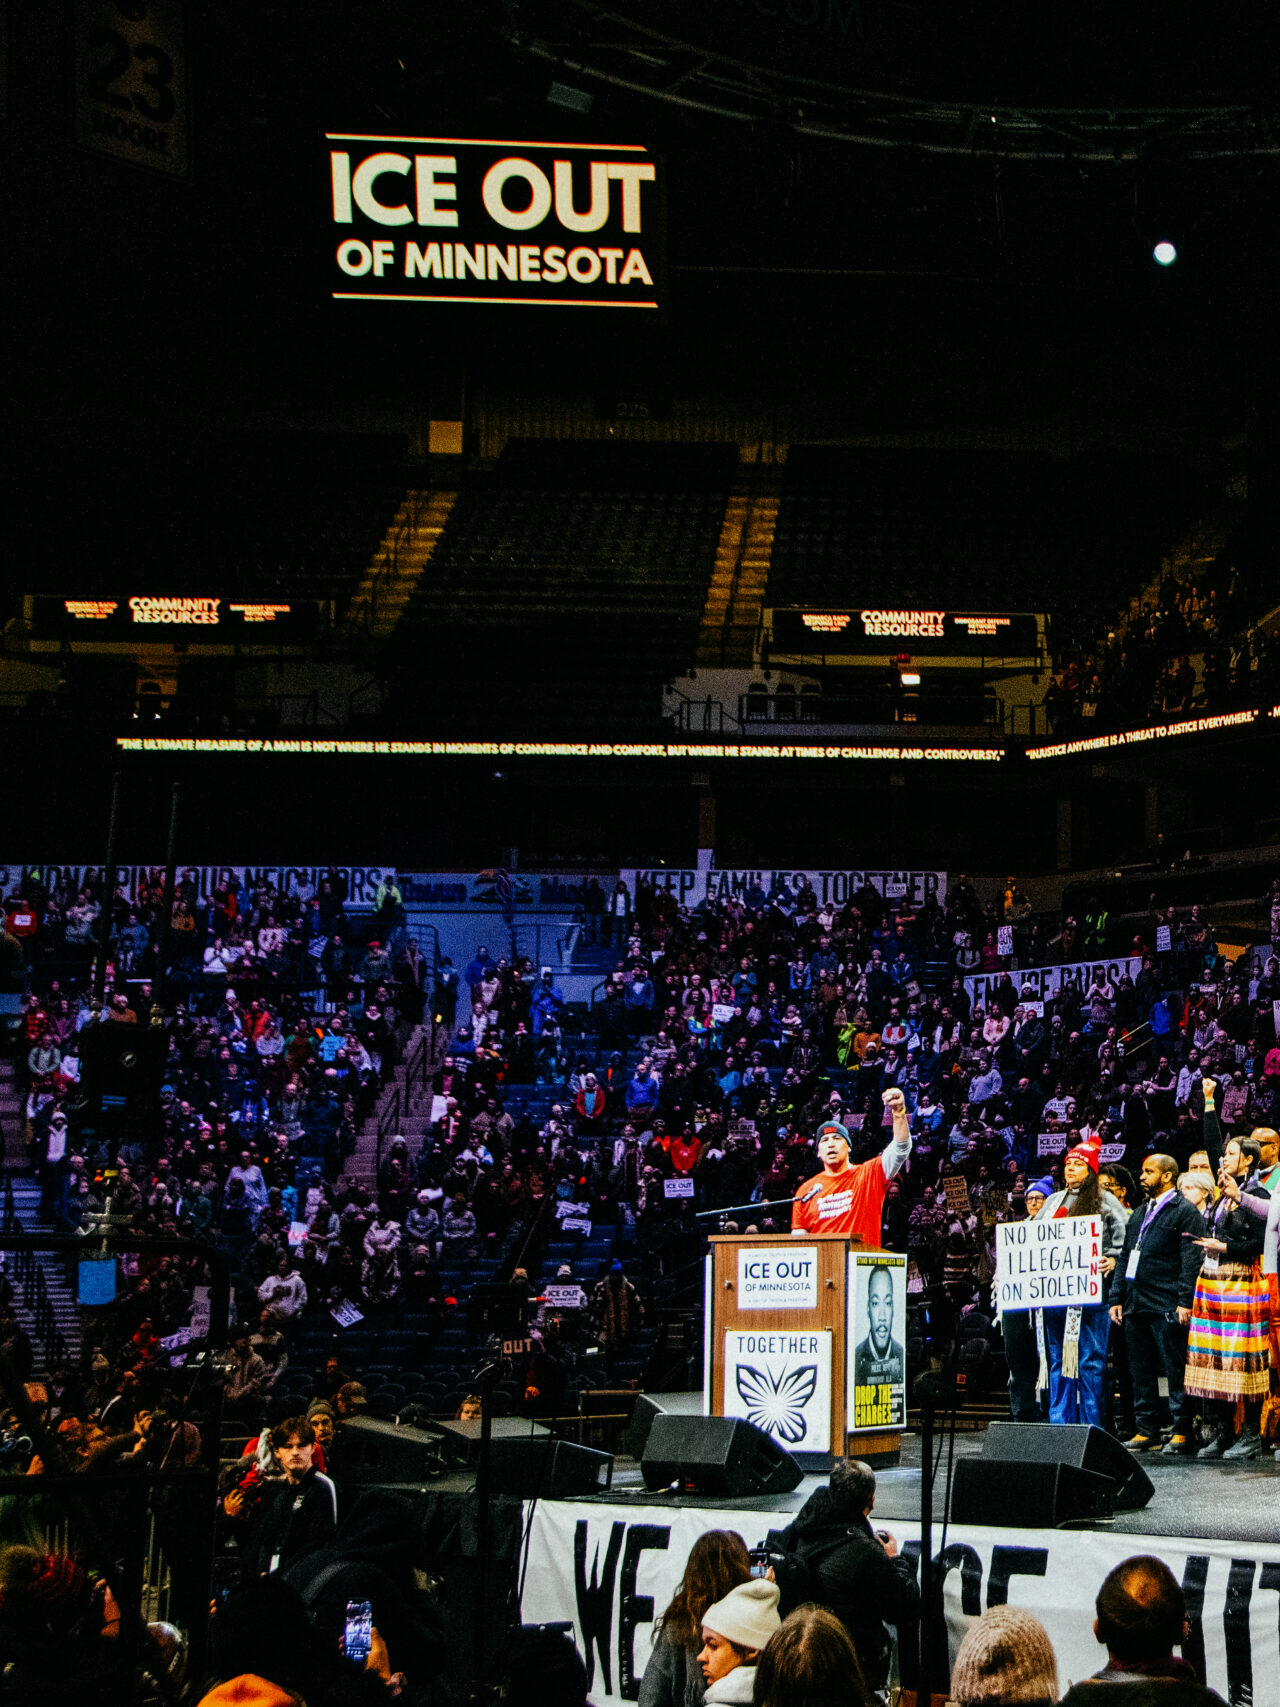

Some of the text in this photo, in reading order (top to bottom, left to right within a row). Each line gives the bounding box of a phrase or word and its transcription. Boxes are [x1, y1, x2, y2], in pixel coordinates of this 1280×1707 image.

[89, 27, 172, 122] 23
[330, 151, 655, 233] ICE OUT
[336, 239, 653, 285] OF MINNESOTA
[129, 596, 221, 612] COMMUNITY
[132, 610, 220, 624] RESOURCES
[861, 610, 945, 625] COMMUNITY
[864, 622, 945, 636] RESOURCES
[144, 738, 194, 750] ULTIMATE
[195, 739, 246, 751] MEASURE
[247, 740, 262, 751] OF
[263, 740, 273, 751] A
[274, 740, 300, 752] MAN
[301, 740, 312, 752] IS
[313, 740, 336, 752] NOT
[337, 741, 374, 753] WHERE
[375, 742, 390, 753] HE
[391, 742, 431, 753] STANDS
[433, 742, 445, 753] IN
[446, 742, 499, 754] MOMENTS
[500, 743, 515, 754] OF
[515, 743, 588, 755] CONVENIENCE
[589, 744, 612, 755] AND
[613, 744, 667, 757] COMFORT,
[668, 745, 688, 756] BUT
[688, 745, 724, 756] WHERE
[725, 745, 739, 757] HE
[740, 745, 779, 757] STANDS
[780, 746, 794, 757] AT
[794, 746, 825, 757] TIMES
[826, 747, 841, 758] OF
[842, 747, 899, 759] CHALLENGE
[900, 748, 923, 759] AND
[1067, 736, 1109, 753] ANYWHERE
[1110, 735, 1117, 745] IS
[1118, 733, 1125, 744] A
[1126, 728, 1155, 743] THREAT
[1156, 726, 1166, 737] TO
[1167, 720, 1197, 736] JUSTICE
[245, 867, 381, 904] NEIGHORS
[819, 872, 939, 907] TOGTHER
[1005, 1221, 1086, 1246] NO ONE IS
[745, 1262, 812, 1279] ICE OUT
[1009, 1245, 1089, 1275] ILLEGAL
[1090, 1222, 1099, 1297] LAND
[745, 1282, 811, 1292] OF MINNESOTA
[1002, 1274, 1087, 1302] ON STOLEN
[503, 1338, 532, 1354] OUT
[737, 1336, 818, 1353] TOGETHER
[855, 1385, 876, 1405] DROP
[878, 1384, 891, 1404] THE
[855, 1404, 891, 1427] CHARGES
[575, 1519, 671, 1701] WE
